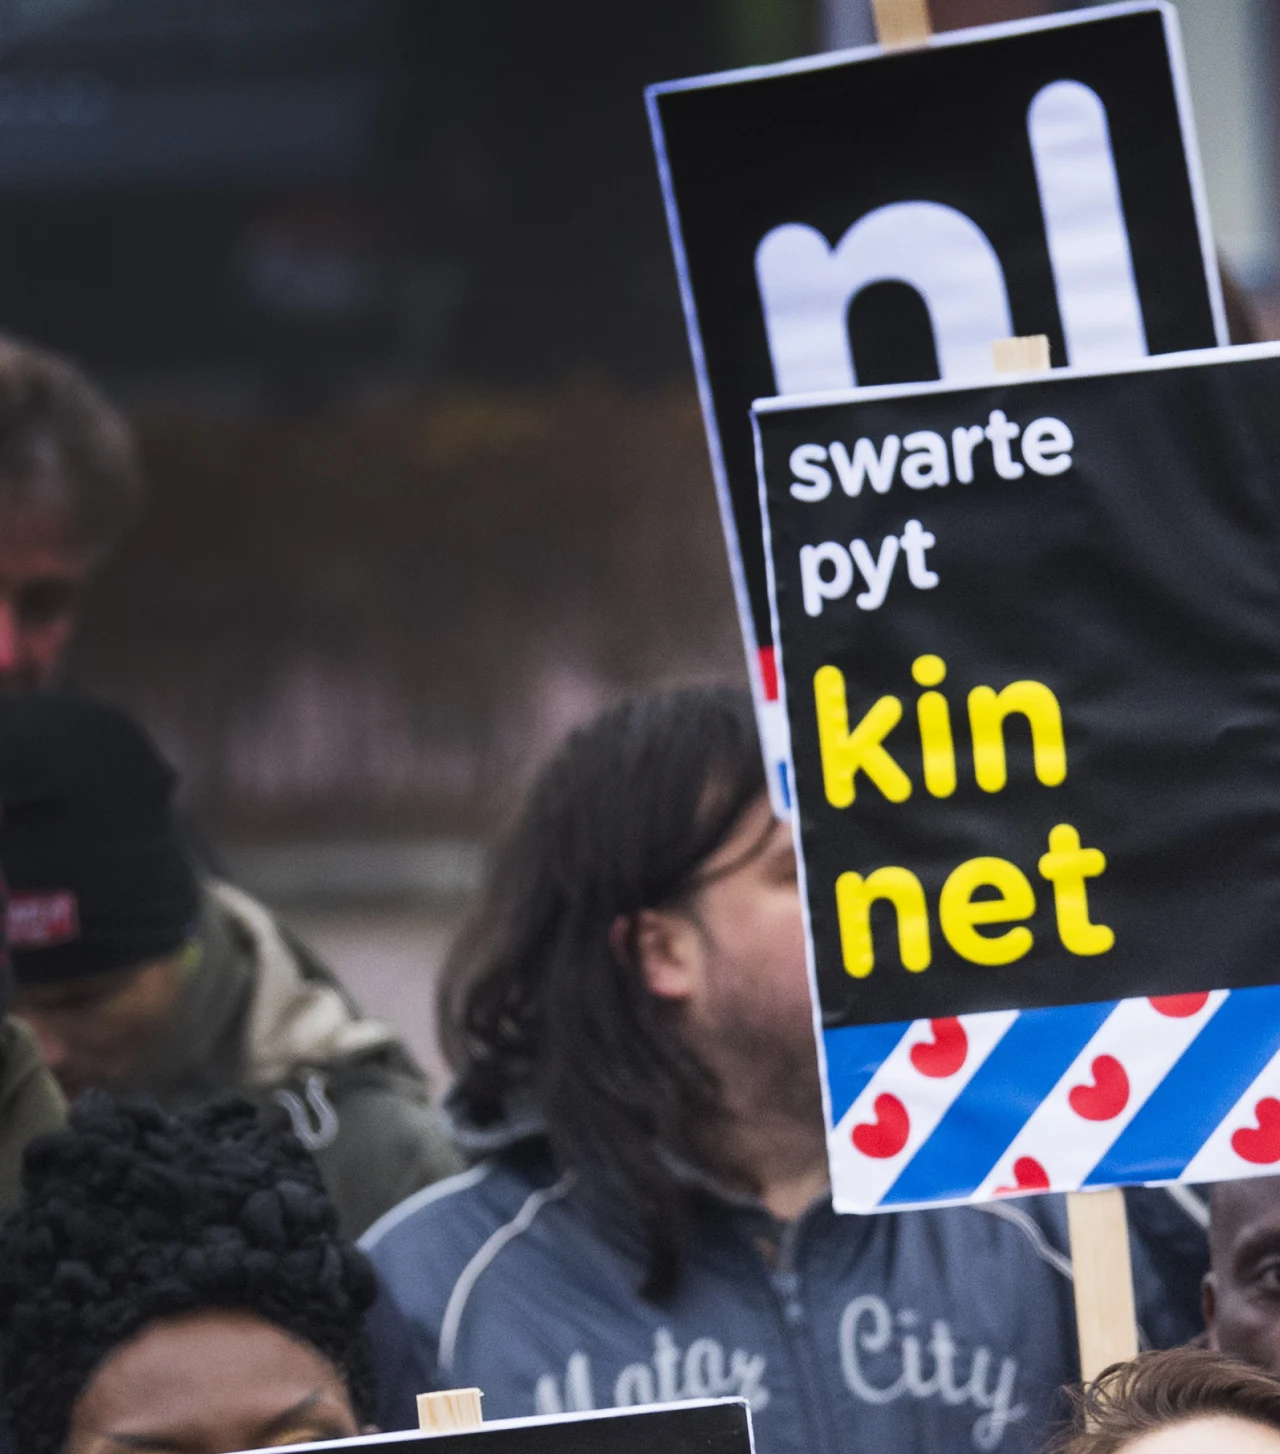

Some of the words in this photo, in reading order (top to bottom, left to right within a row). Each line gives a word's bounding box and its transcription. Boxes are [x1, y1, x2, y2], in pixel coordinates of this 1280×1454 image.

[790, 409, 1074, 502] swarte
[800, 519, 939, 616] pyt
[814, 654, 1067, 808] kin
[835, 824, 1114, 978] net
[839, 1295, 1027, 1449] City
